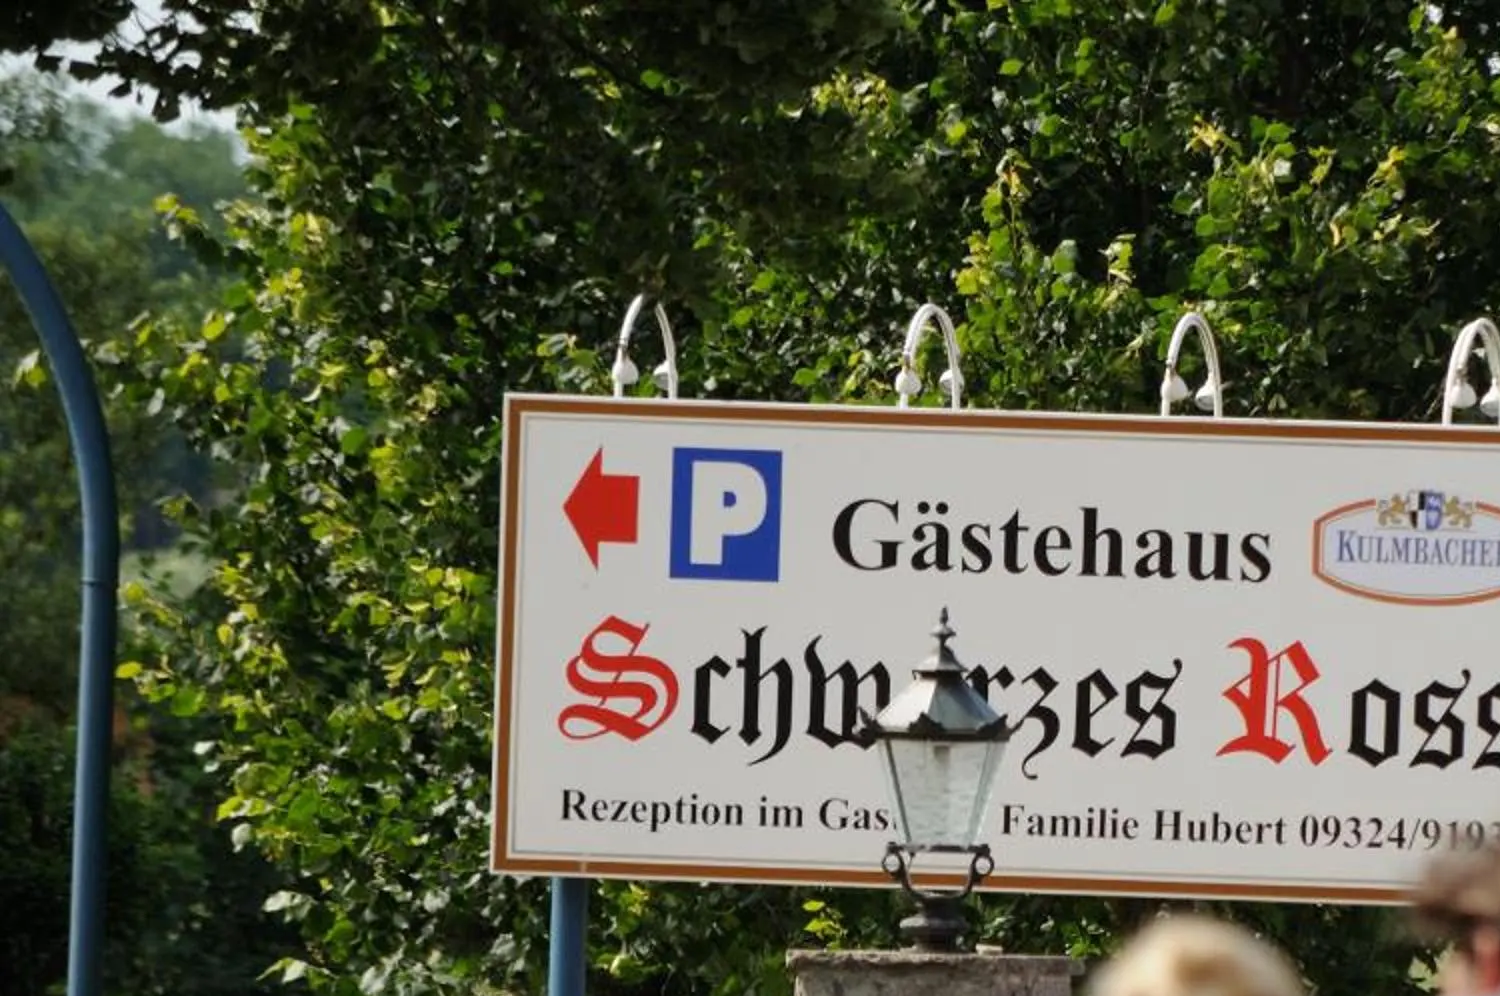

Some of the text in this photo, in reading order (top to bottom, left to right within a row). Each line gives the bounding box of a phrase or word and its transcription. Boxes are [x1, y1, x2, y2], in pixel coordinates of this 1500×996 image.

[689, 460, 768, 566] P
[832, 498, 1272, 584] Gästehaus
[557, 615, 1183, 780] Schwrzes
[561, 788, 744, 833] Rezeption
[759, 795, 804, 829] im
[818, 796, 898, 831] Gas
[1002, 804, 1139, 840] Familie
[1154, 809, 1286, 845] Hubert
